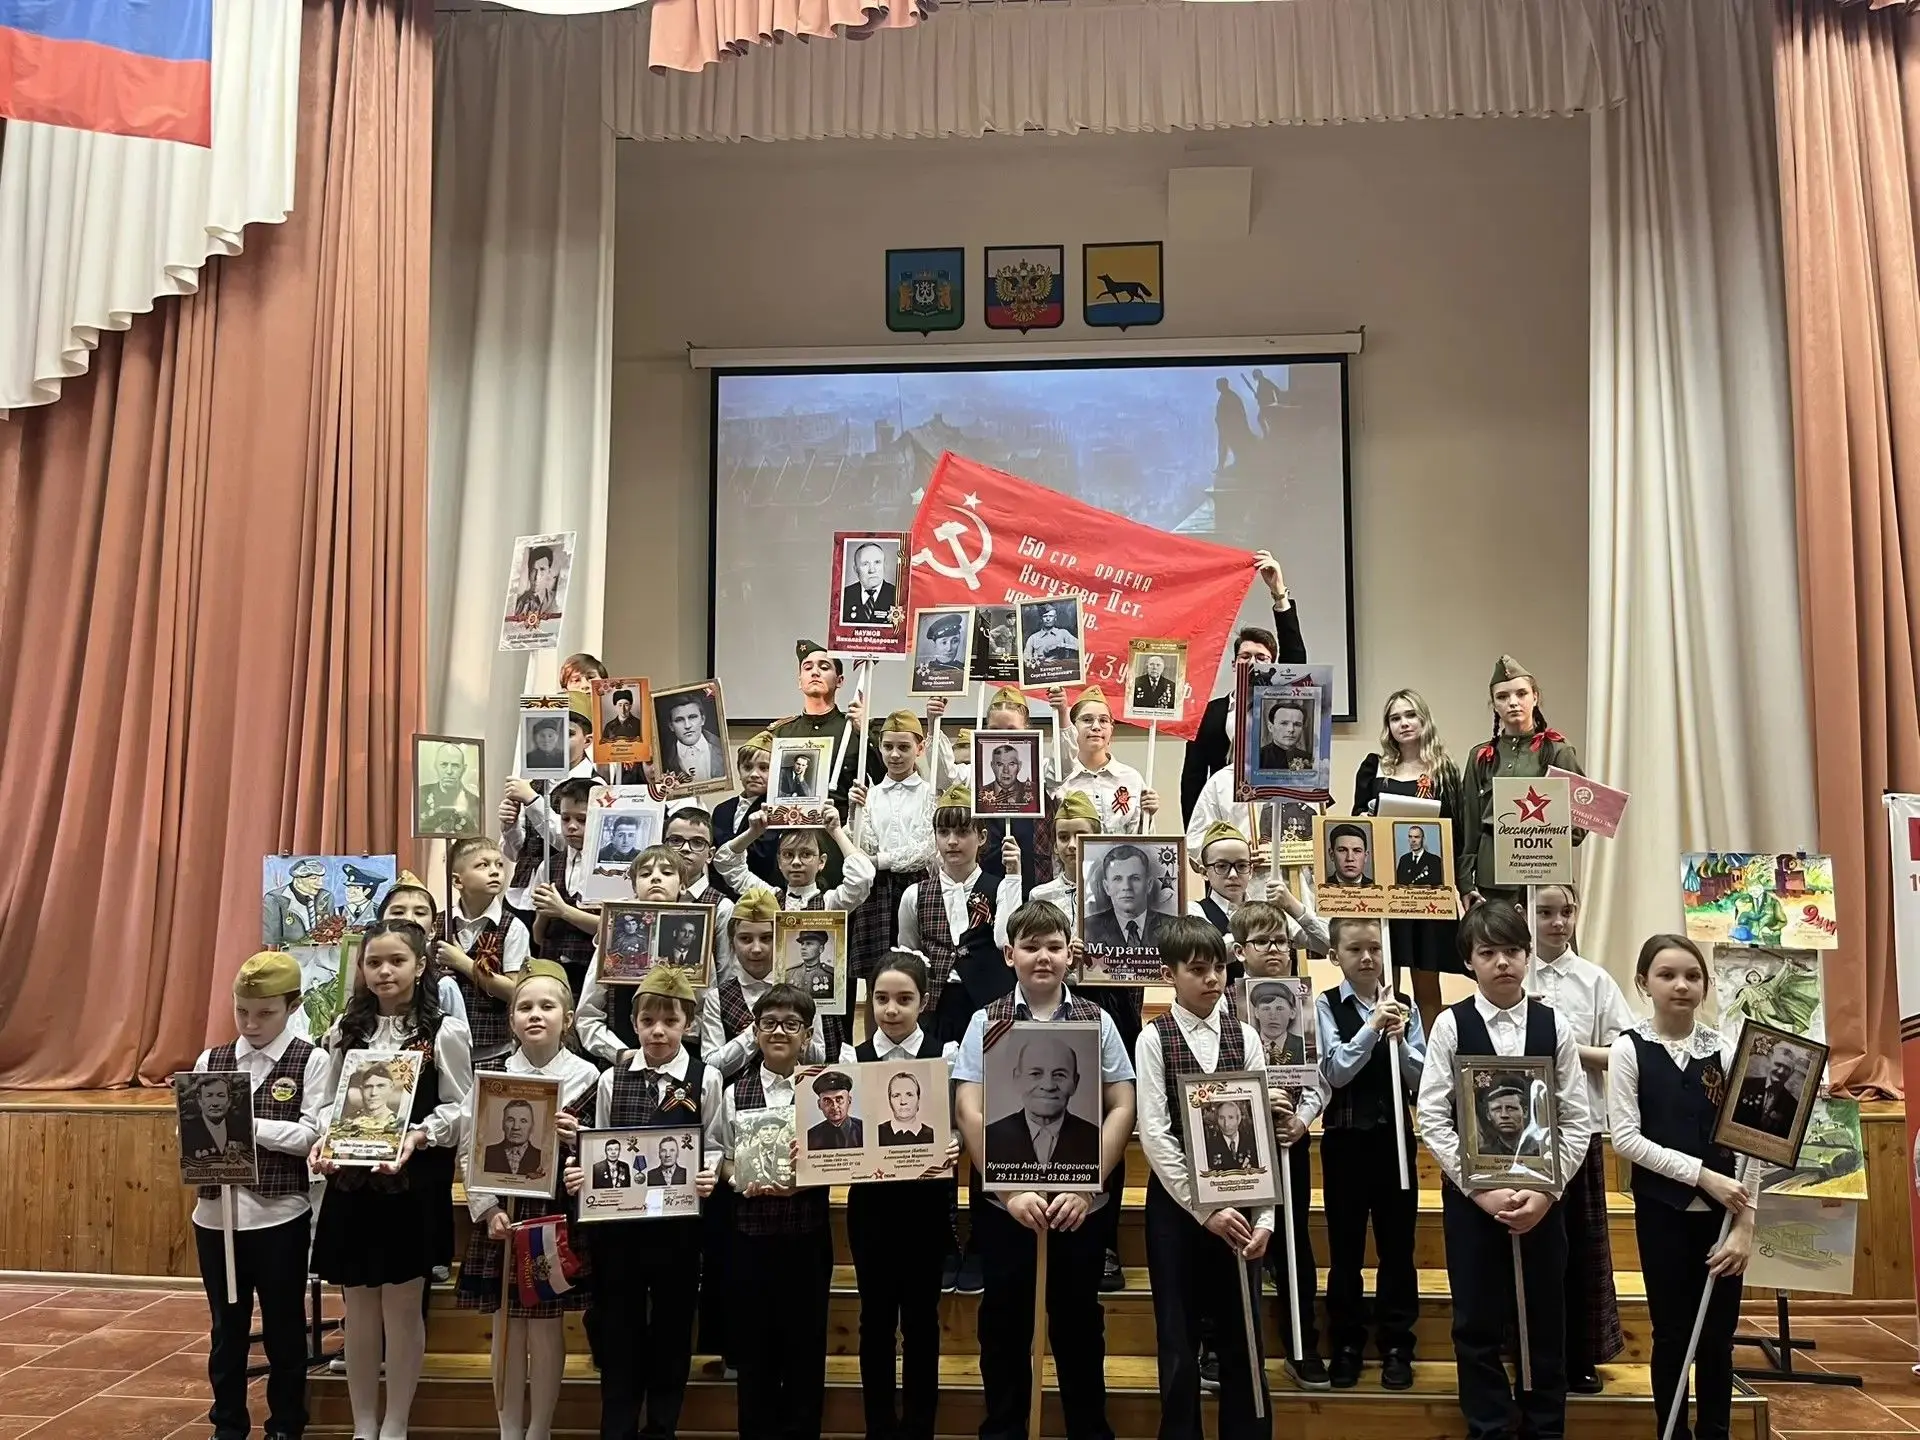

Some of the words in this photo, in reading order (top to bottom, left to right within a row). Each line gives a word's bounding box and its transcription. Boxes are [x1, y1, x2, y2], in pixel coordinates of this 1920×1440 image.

[1017, 535, 1046, 560] 150
[1094, 563, 1153, 593] ОРДЕНА
[854, 629, 881, 637] НАУМОВ
[863, 636, 899, 645] Фёдорович
[1498, 812, 1569, 837] бессмертный
[1514, 838, 1553, 849] ПОЛК
[1126, 957, 1161, 965] Савельеви
[1021, 1161, 1053, 1171] Андрей
[1053, 1161, 1100, 1170] Георгиевич
[995, 1172, 1039, 1181] 29.11.1913
[1047, 1173, 1091, 1181] 03.08.1990
